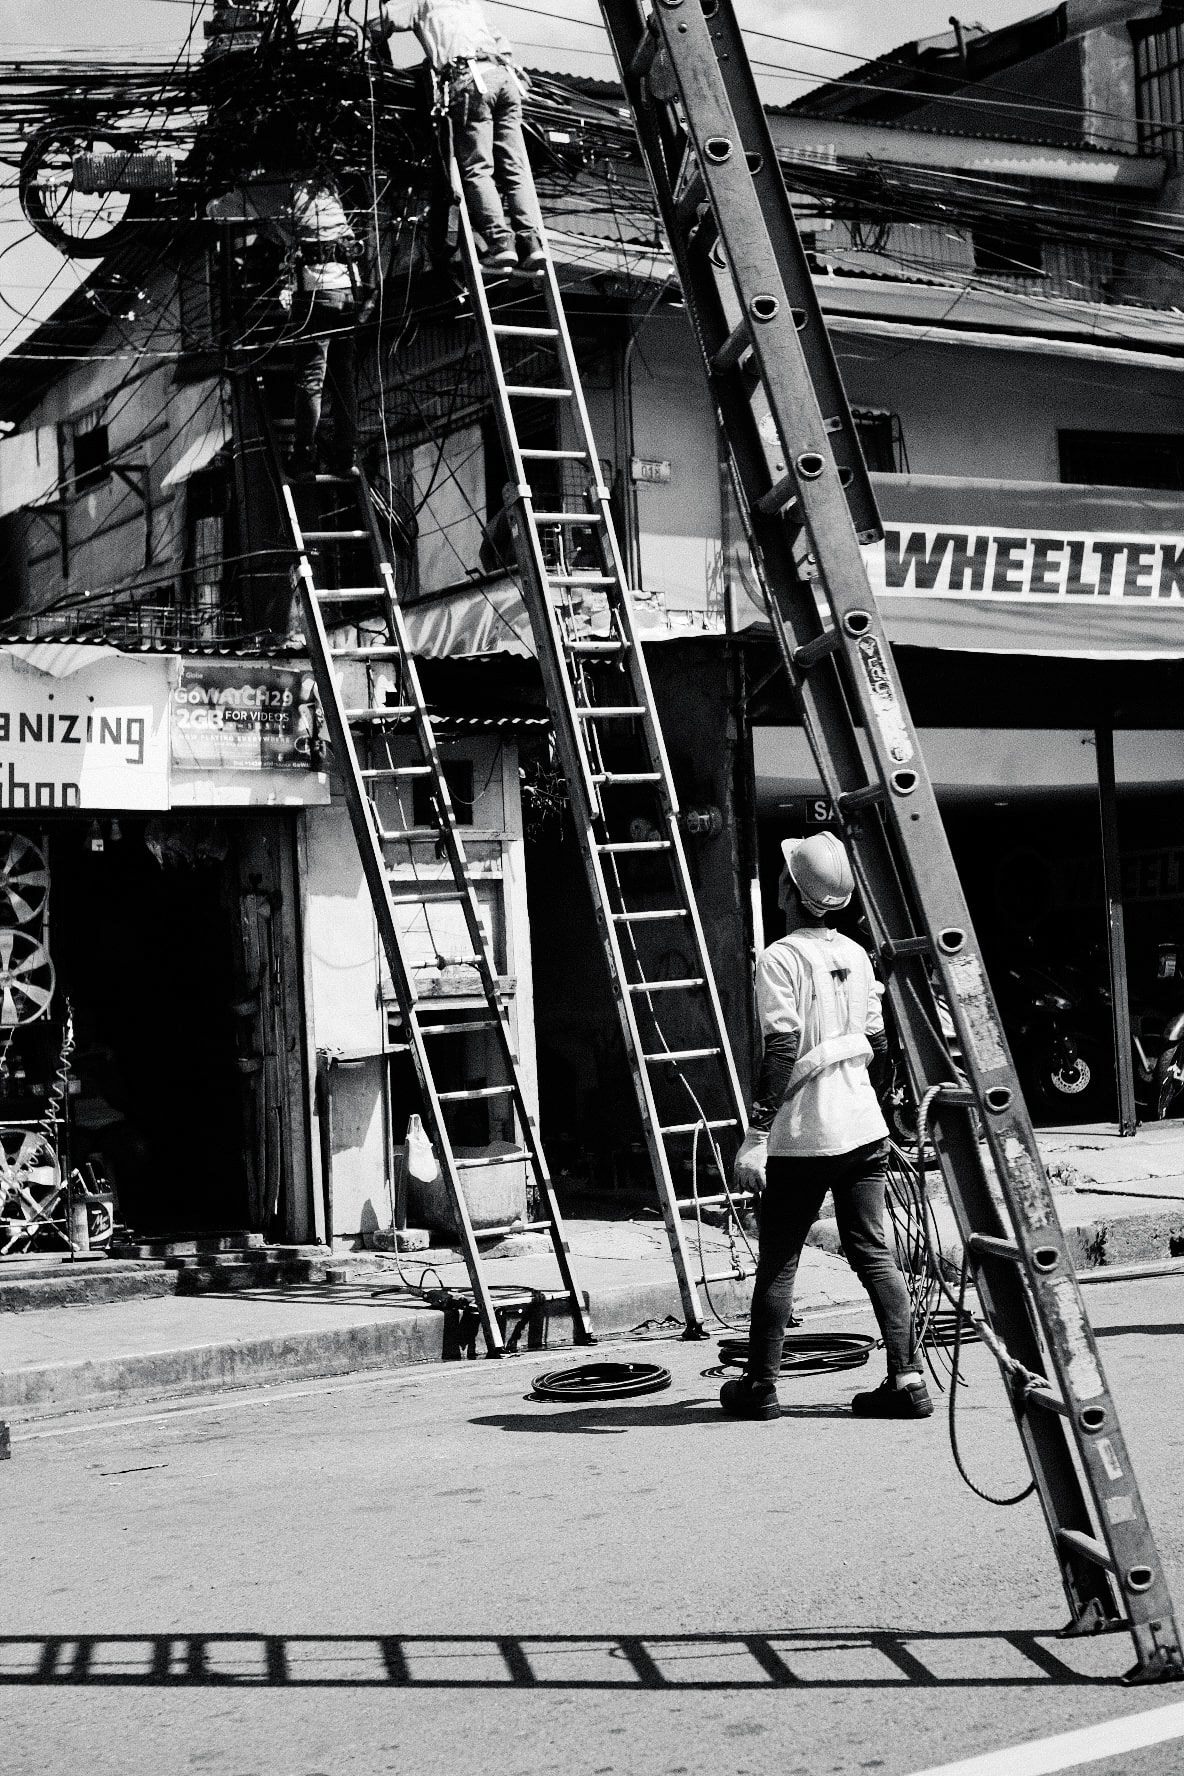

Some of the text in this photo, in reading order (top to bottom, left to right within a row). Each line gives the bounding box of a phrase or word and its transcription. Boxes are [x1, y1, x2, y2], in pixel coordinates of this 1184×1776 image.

[884, 530, 1184, 598] WHEELTEK
[175, 708, 290, 730] 2GB FOR VIDEOS
